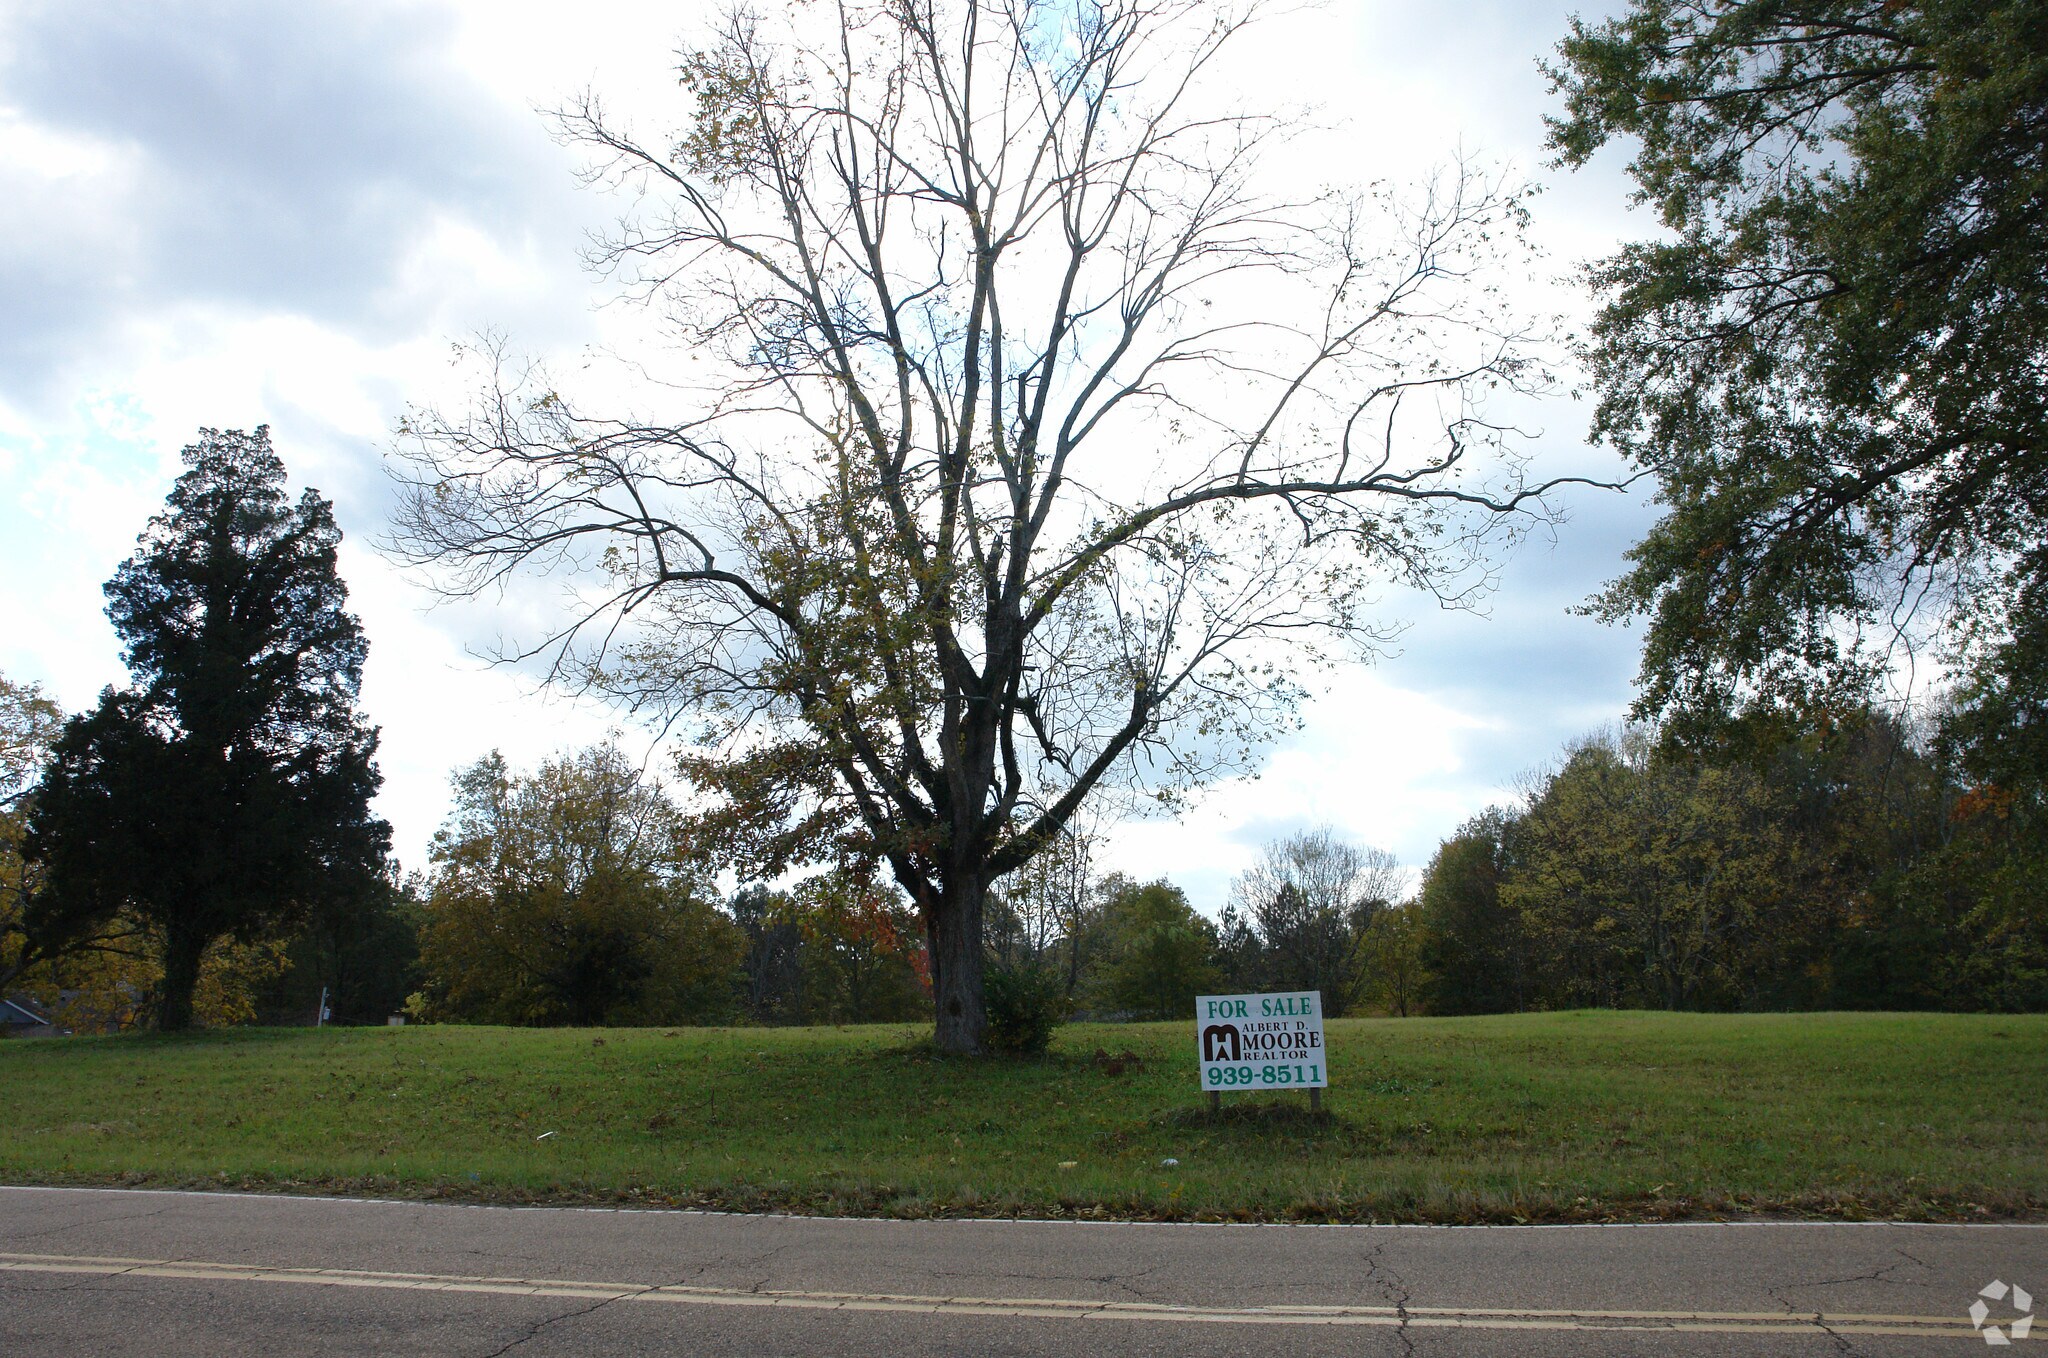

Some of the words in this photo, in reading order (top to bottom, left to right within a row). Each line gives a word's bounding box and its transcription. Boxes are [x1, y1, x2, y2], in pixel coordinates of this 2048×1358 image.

[1207, 1000, 1249, 1019] FOR
[1261, 997, 1312, 1017] SALE
[1242, 1022, 1288, 1032] ALBERT
[1296, 1021, 1308, 1030] D.
[1242, 1031, 1321, 1050] MOORE
[1244, 1050, 1308, 1061] REALTOR
[1207, 1064, 1321, 1085] 939-8511
